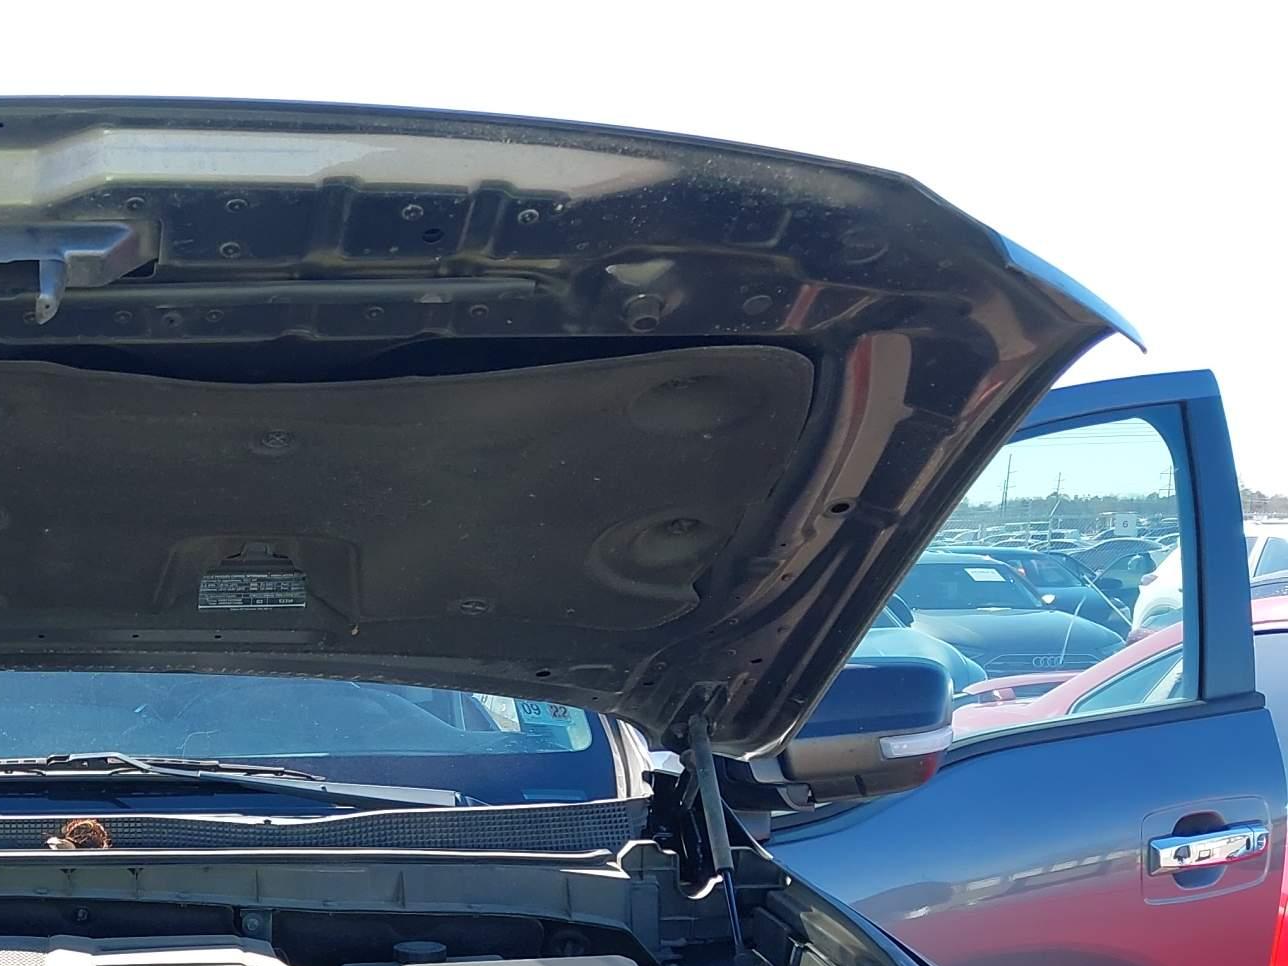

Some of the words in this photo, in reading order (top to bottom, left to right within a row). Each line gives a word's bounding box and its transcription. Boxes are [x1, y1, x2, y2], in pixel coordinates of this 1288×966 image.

[1122, 520, 1129, 528] 6
[522, 703, 541, 716] 09
[550, 705, 568, 717] 22
